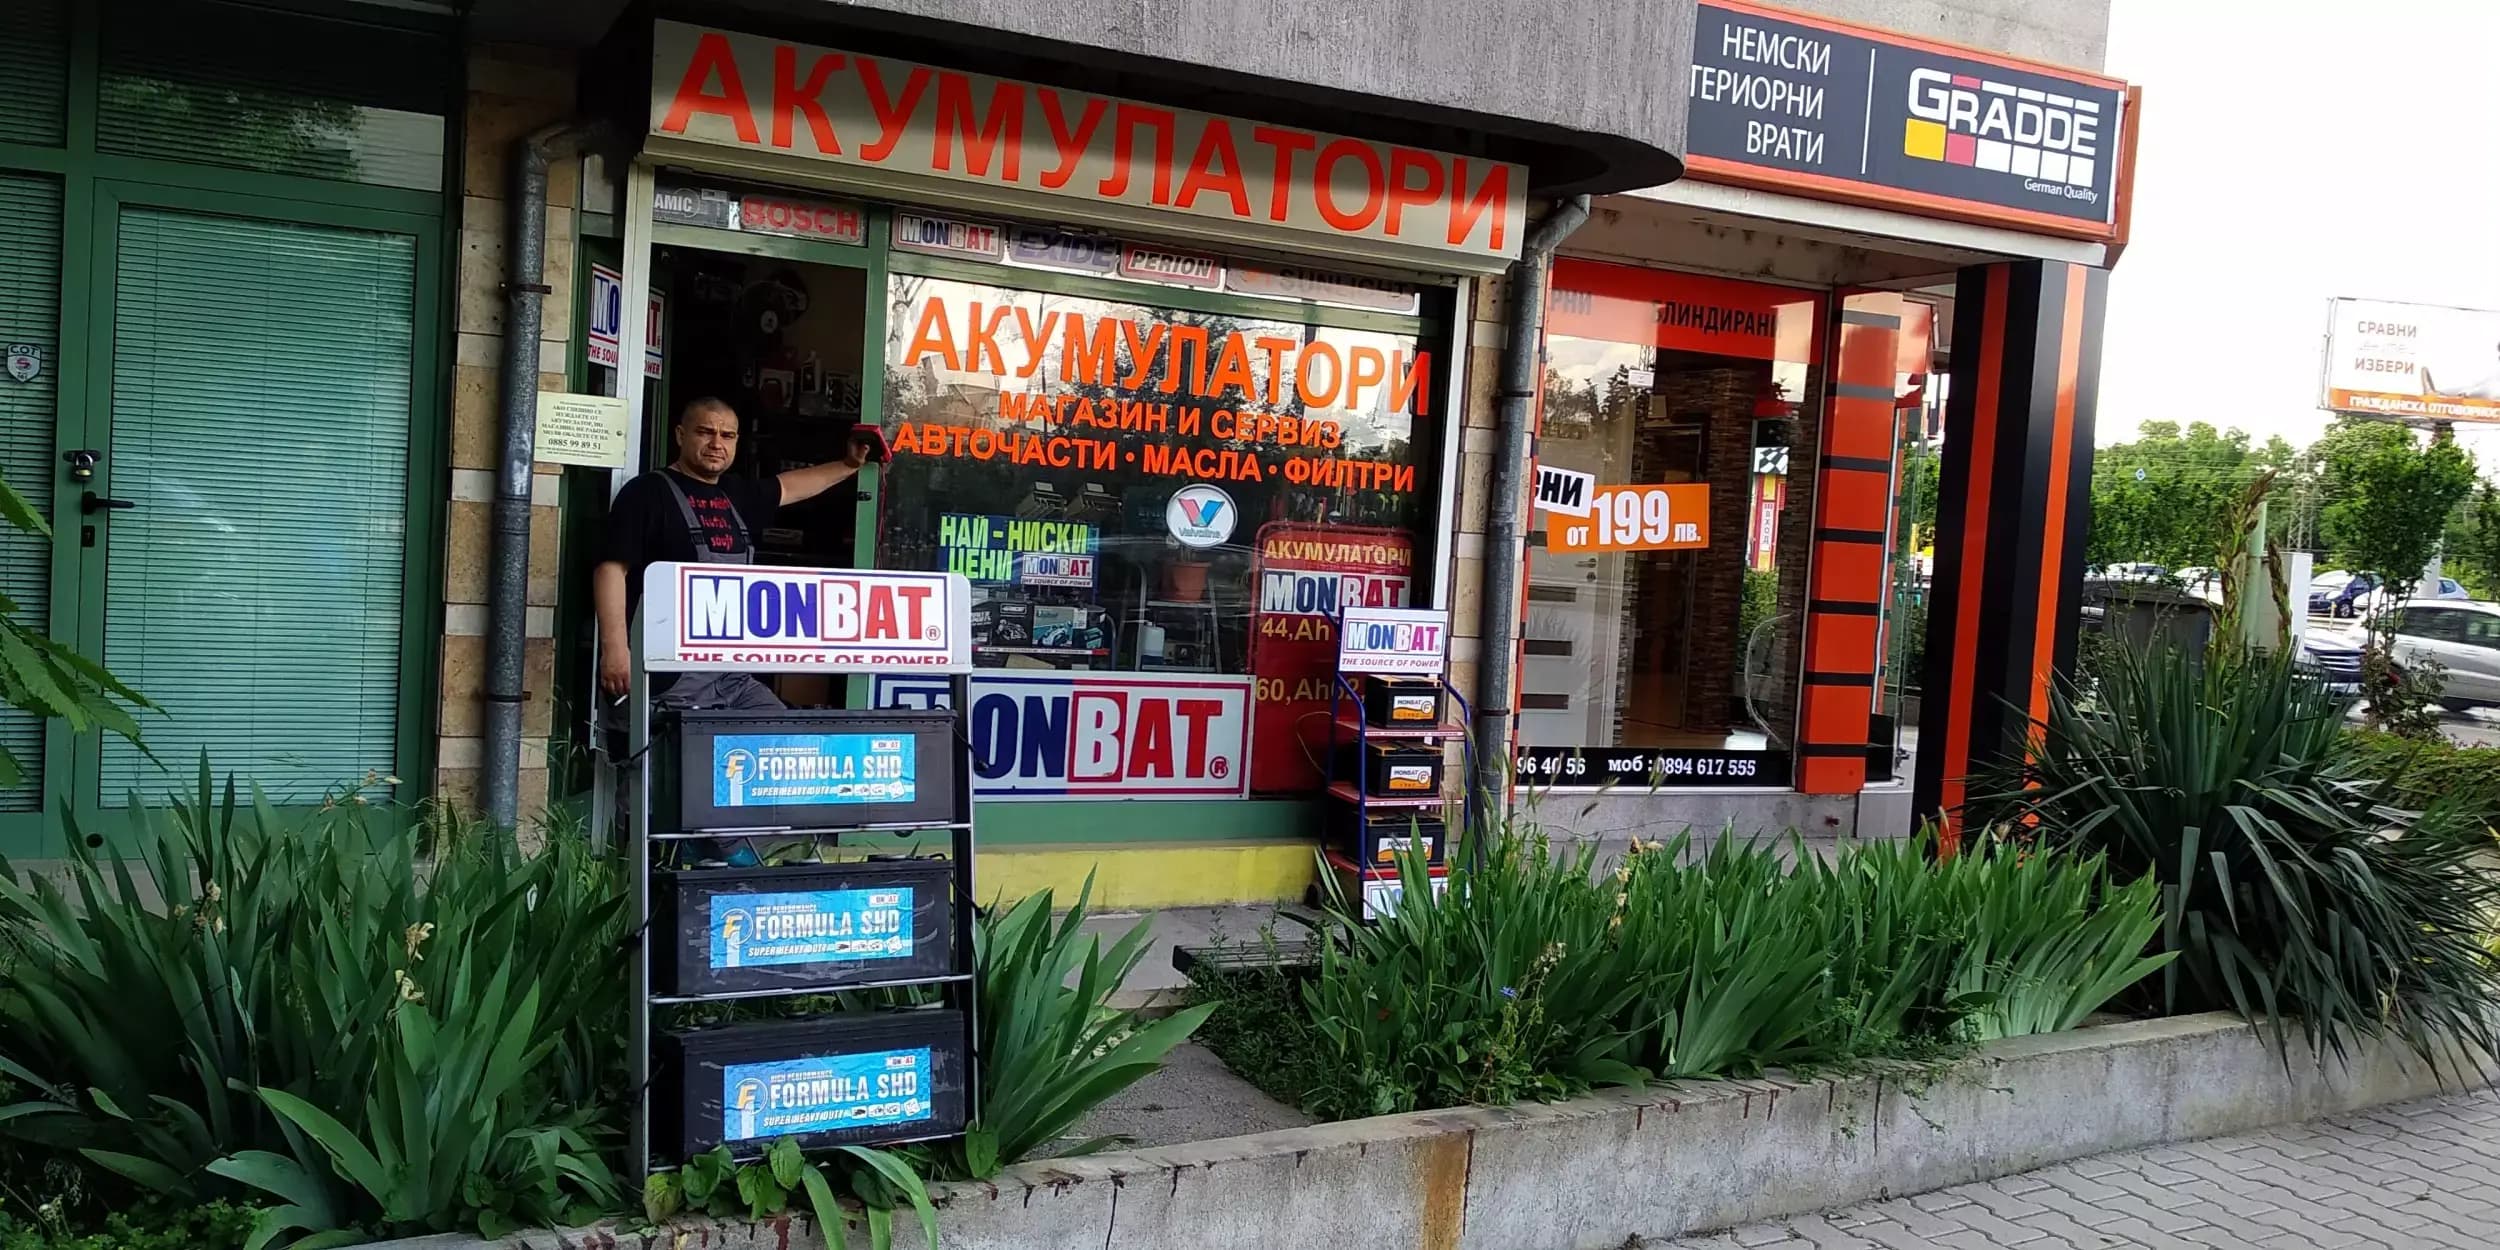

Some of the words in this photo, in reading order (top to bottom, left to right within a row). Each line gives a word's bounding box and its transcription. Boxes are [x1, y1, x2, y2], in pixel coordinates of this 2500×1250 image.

[1722, 24, 1831, 75] НЕМСКИ
[661, 32, 1509, 251] АКУМУЛАТОРИ
[1746, 121, 1824, 165] ВРАТИ
[2024, 178, 2063, 197] German
[2063, 184, 2098, 204] Quality
[742, 197, 858, 237] BOSCH
[1015, 229, 1115, 267] EXIDE
[1131, 249, 1214, 278] PERION
[2358, 321, 2417, 338] СРАВНИ
[903, 296, 1431, 416] АКУМУЛАТОРИ
[2355, 357, 2415, 375] ИЗБЕРИ
[1000, 390, 1168, 433] МАГАЗИН
[1177, 406, 1201, 436] И
[1210, 408, 1341, 449] СЕРВИЗ
[548, 438, 568, 447] 0885
[592, 442, 601, 450] 51
[892, 422, 1117, 471] АВТОЧАСТИ
[1142, 444, 1263, 482] МАСЛА
[1284, 456, 1416, 493] ФИЛТРИ
[1592, 489, 1670, 545] 199
[949, 547, 1013, 581] ЦЕНИ
[1264, 540, 1411, 567] АКУМУЛАТОРИ
[1342, 657, 1357, 665] THE
[1360, 658, 1394, 666] SOURCE
[1397, 659, 1408, 667] OF
[758, 755, 855, 782] FORMULA
[862, 755, 903, 779] SHD
[1697, 759, 1725, 776] 617
[1728, 759, 1756, 776] 555
[755, 911, 853, 940] FORMULA
[860, 909, 900, 935] SHD
[770, 1076, 870, 1109] FORMULA
[876, 1071, 917, 1099] SHD
